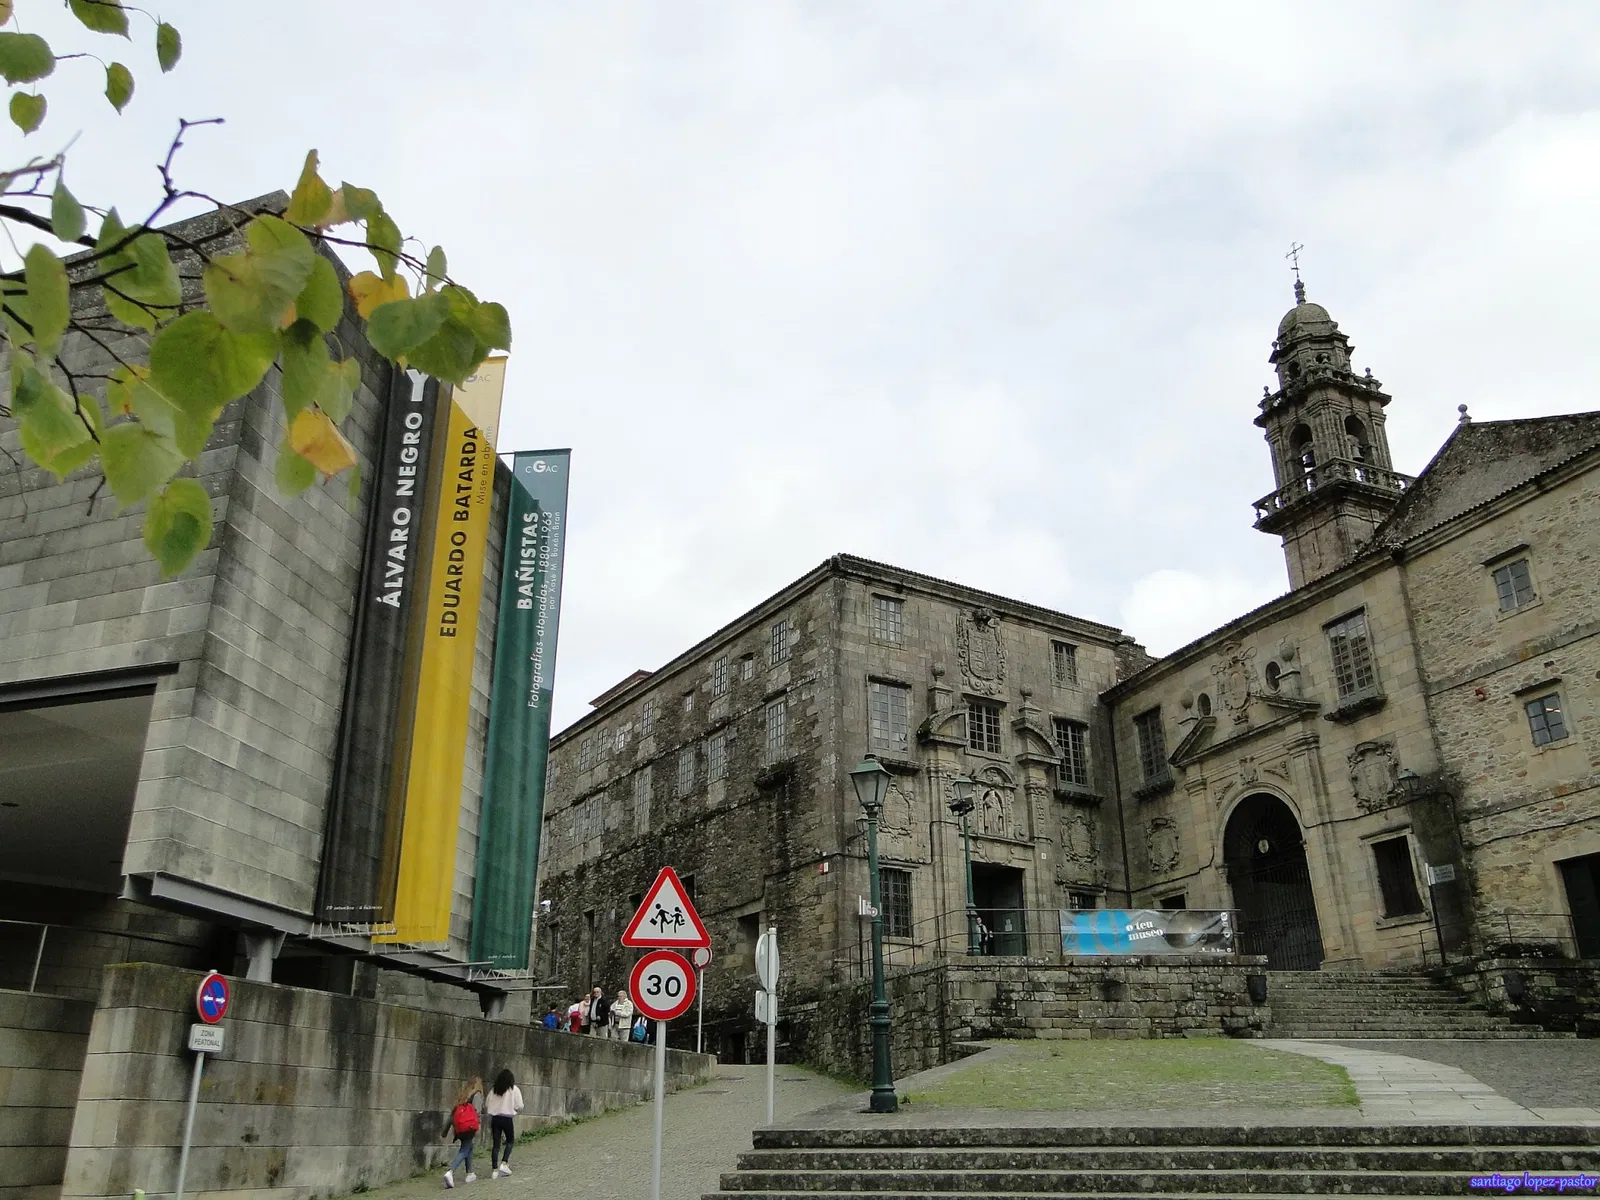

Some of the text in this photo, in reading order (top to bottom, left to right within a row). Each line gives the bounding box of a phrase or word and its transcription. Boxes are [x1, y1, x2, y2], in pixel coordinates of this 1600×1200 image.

[405, 368, 430, 402] Y
[475, 425, 493, 505] Mise en abyme
[375, 412, 423, 608] ÁLVARO NEGRO
[552, 511, 561, 530] Bran
[439, 426, 480, 638] EDUARDO BATARDA
[514, 512, 539, 610] BAÑISTAS
[550, 560, 558, 571] M.
[549, 573, 557, 593] Xosé
[527, 511, 553, 709] Fotografías atopadas, 1880-1963
[549, 596, 557, 610] por
[1125, 921, 1154, 932] o teu
[1127, 928, 1164, 941] museo
[646, 974, 682, 998] 30
[194, 1038, 220, 1046] PEATONAL
[200, 1029, 215, 1037] ZONA
